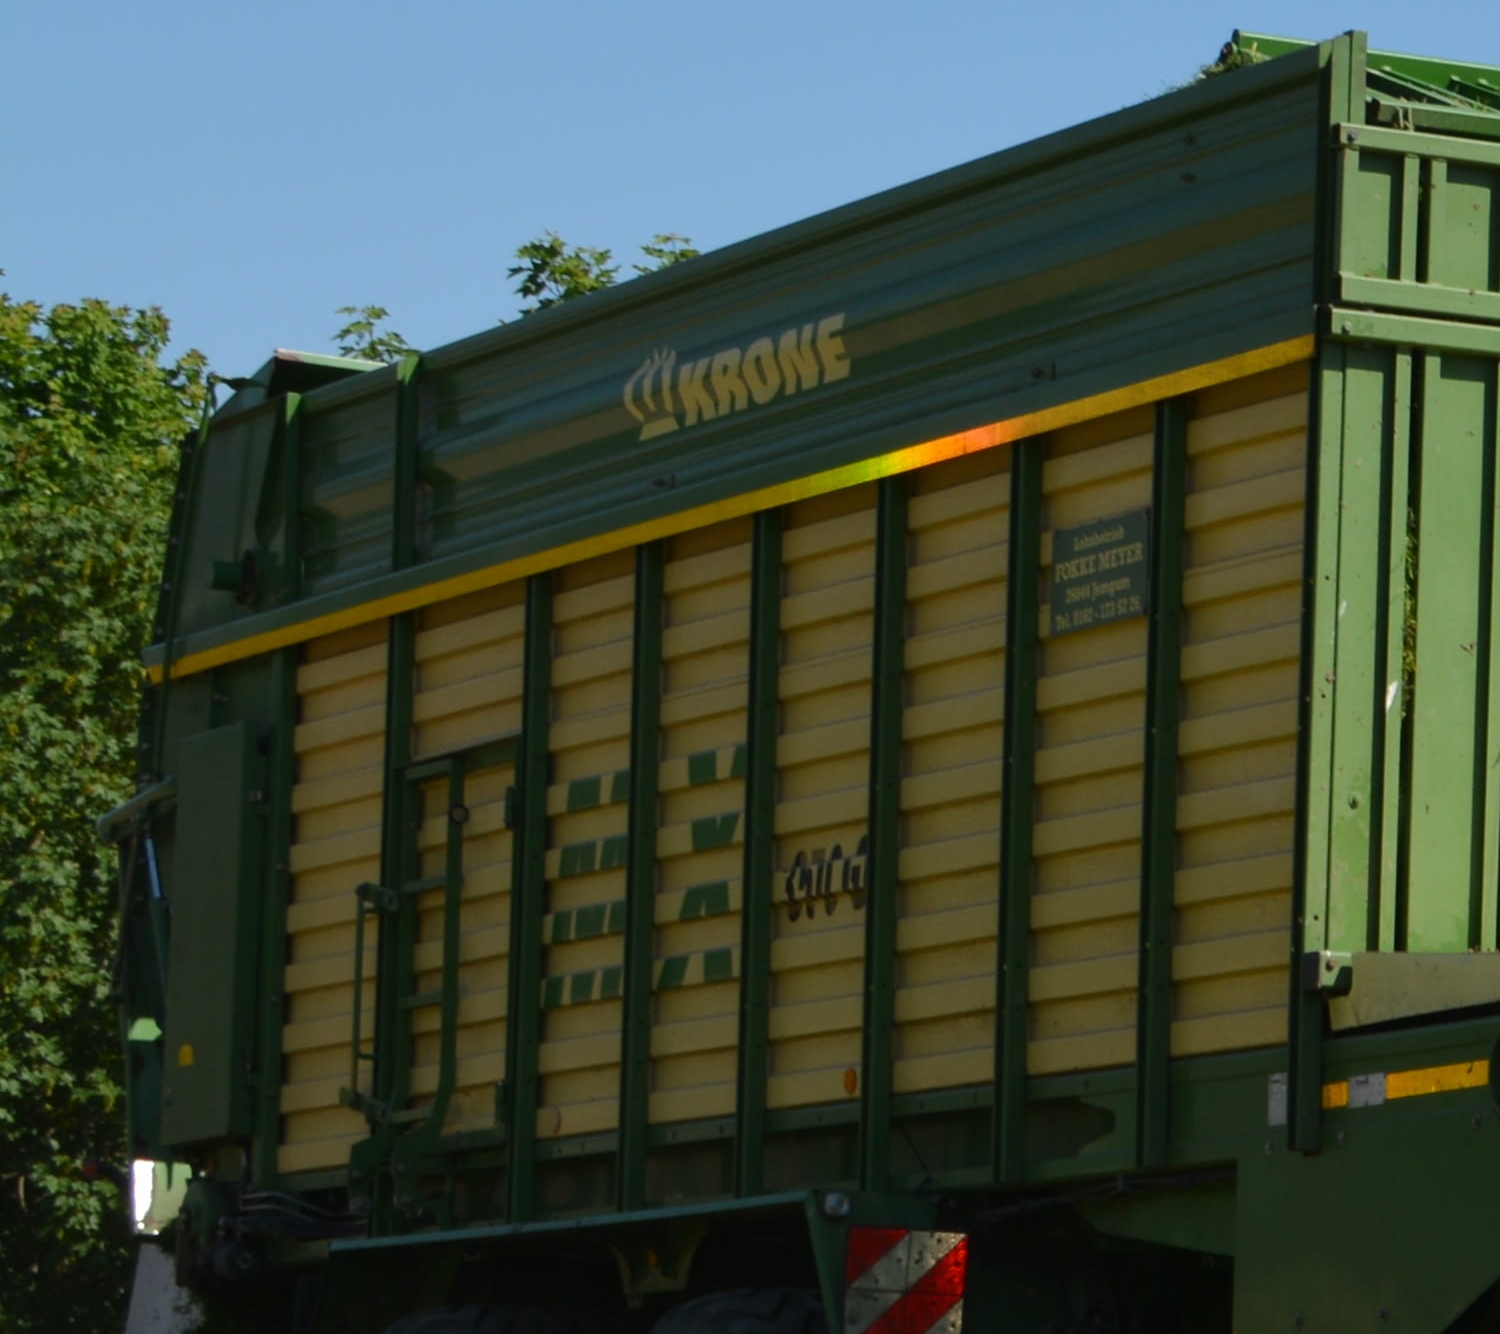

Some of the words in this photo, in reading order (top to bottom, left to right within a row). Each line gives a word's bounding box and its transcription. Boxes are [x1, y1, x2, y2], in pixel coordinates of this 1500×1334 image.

[677, 312, 851, 428] KRONE
[1055, 554, 1097, 584] FOKKE
[1097, 542, 1144, 572] MEYER
